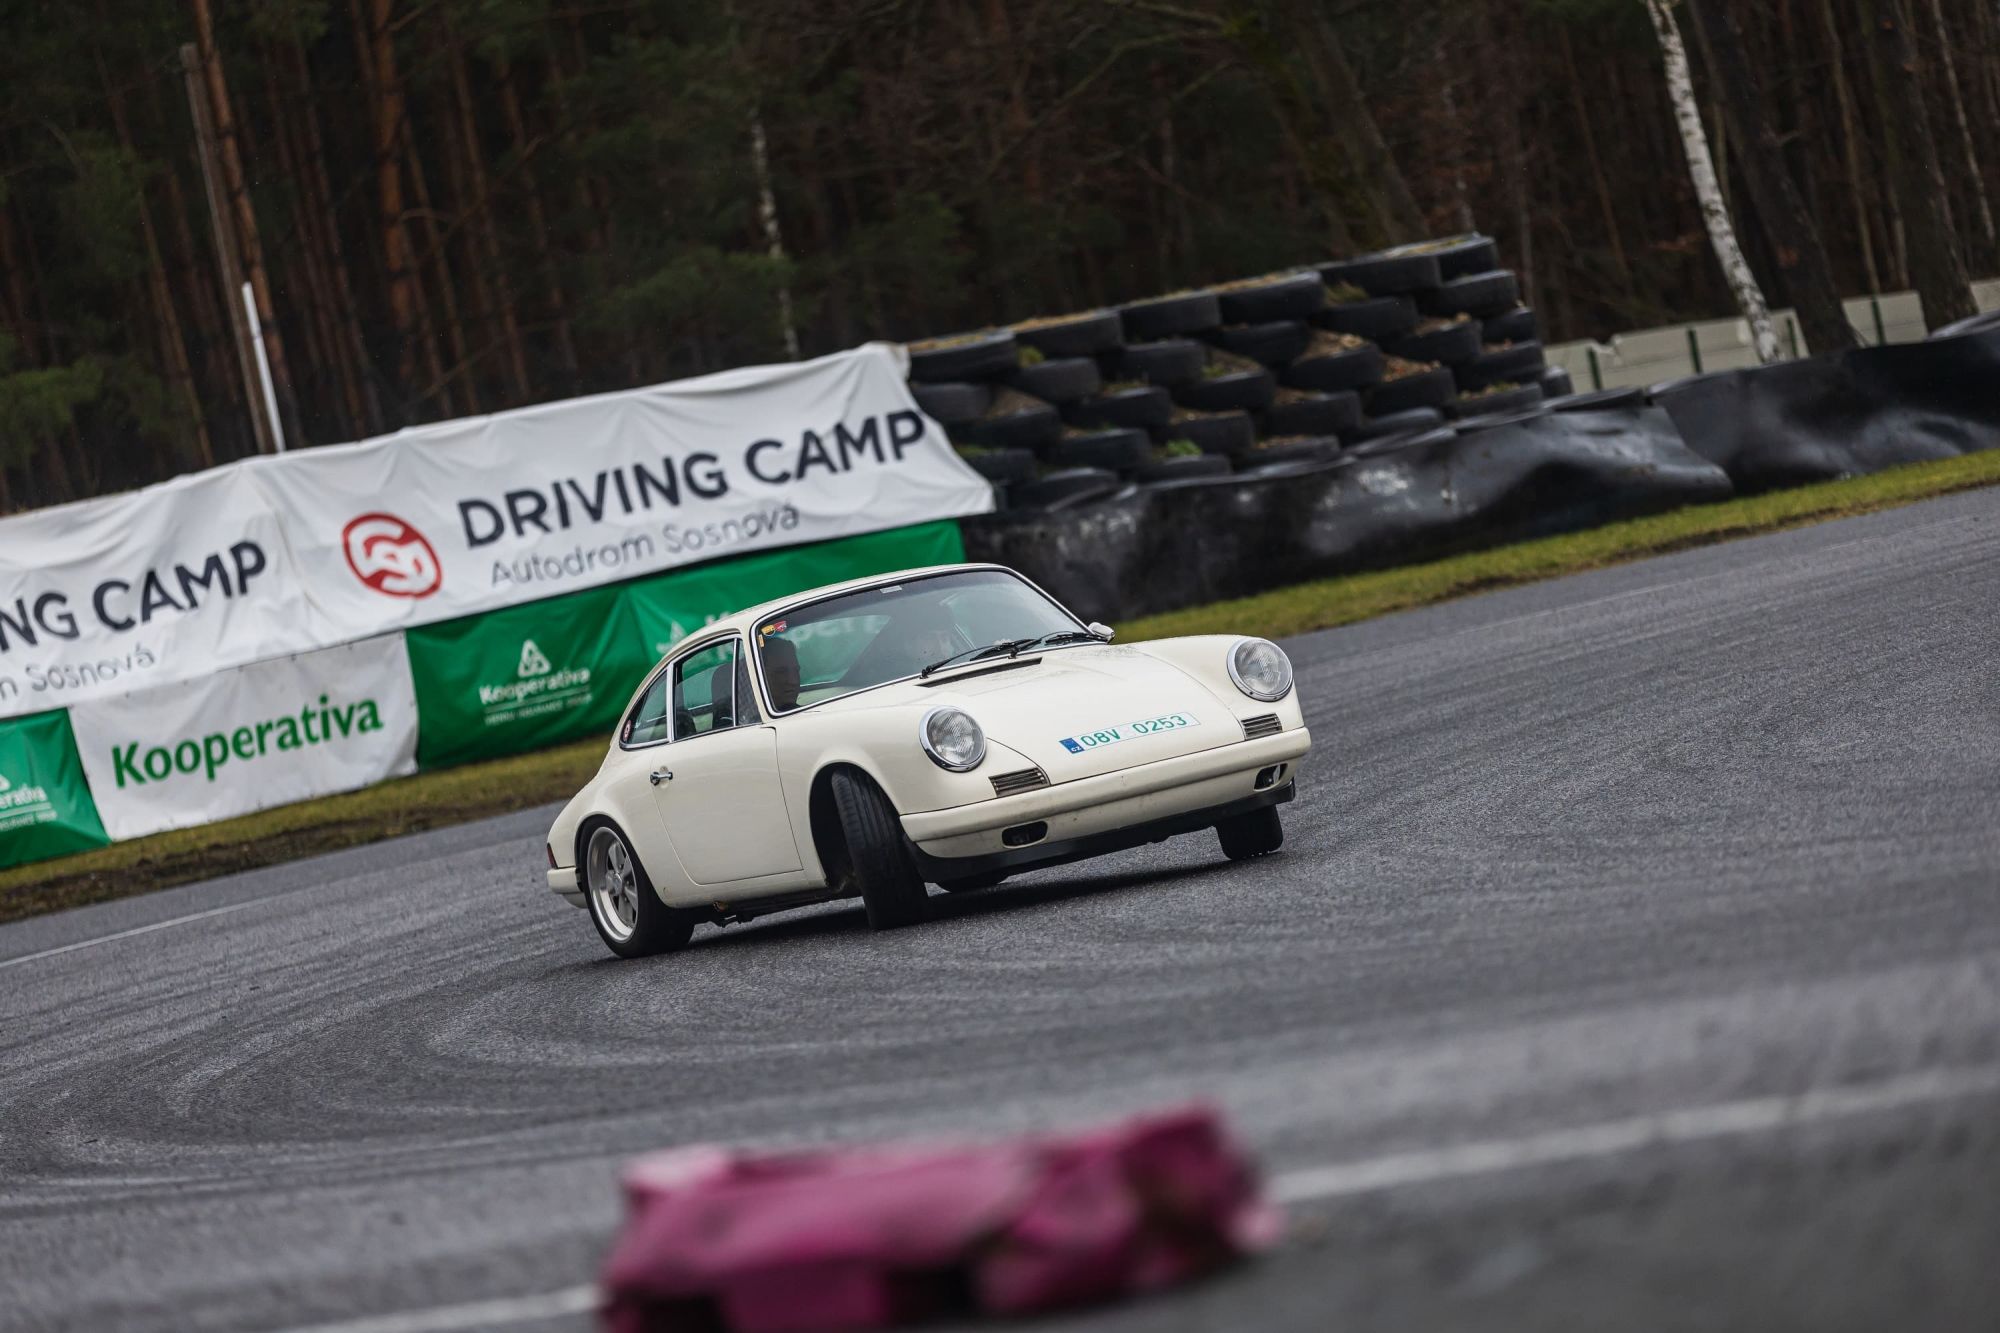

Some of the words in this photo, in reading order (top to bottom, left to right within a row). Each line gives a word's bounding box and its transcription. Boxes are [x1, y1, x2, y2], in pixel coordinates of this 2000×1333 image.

[458, 452, 729, 549] DRIVING
[744, 409, 925, 485] CAMP
[92, 541, 267, 632] CAMP
[491, 532, 655, 588] Autodrom
[662, 500, 801, 553] Sosnová
[25, 642, 155, 692] Sosnová
[111, 693, 384, 789] Kooperativa
[1080, 729, 1121, 747] 08V
[1132, 715, 1188, 734] 0253
